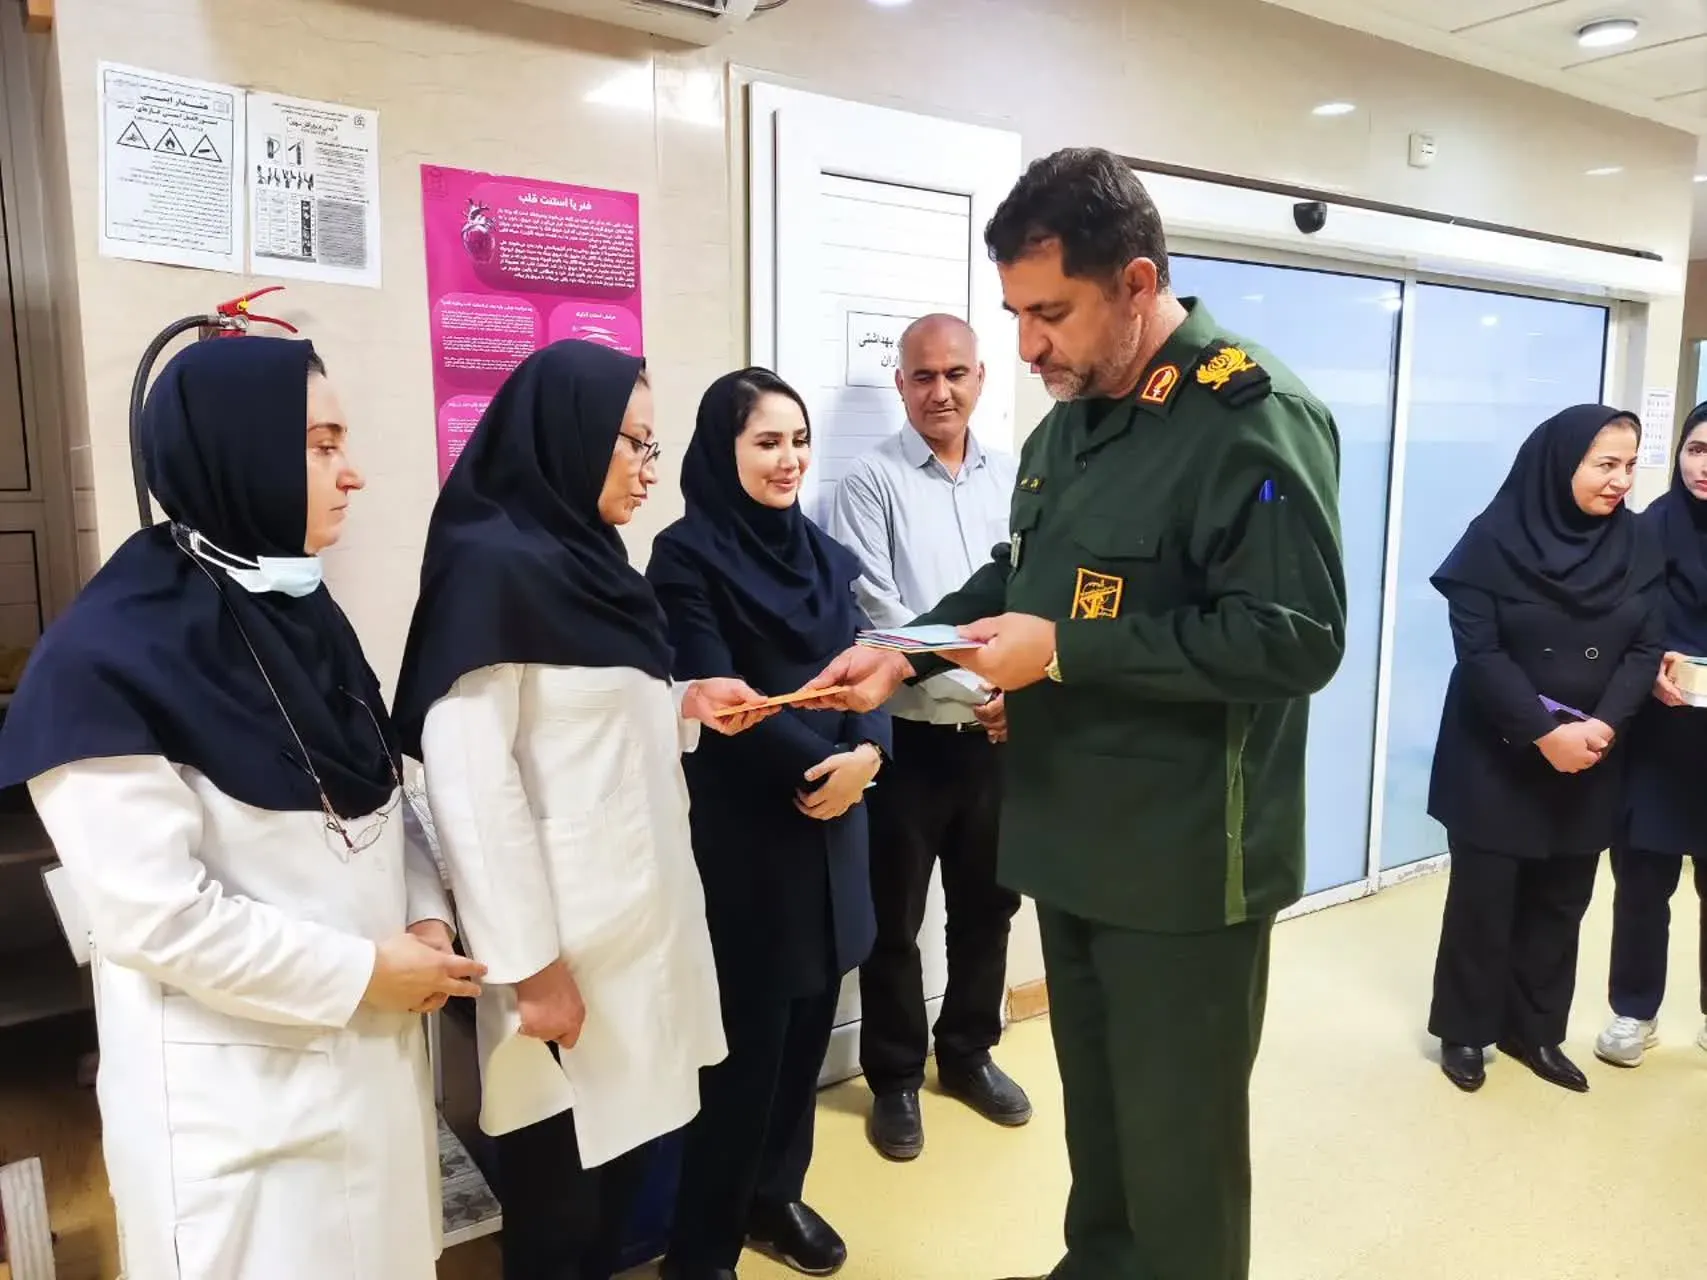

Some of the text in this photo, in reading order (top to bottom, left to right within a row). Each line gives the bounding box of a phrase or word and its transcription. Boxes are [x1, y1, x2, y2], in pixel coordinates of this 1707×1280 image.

[140, 95, 209, 110] هشدار ایمنی
[518, 192, 539, 204] قلب
[540, 195, 568, 208] استنت
[569, 198, 577, 211] یا
[858, 332, 895, 348] بهداشتی
